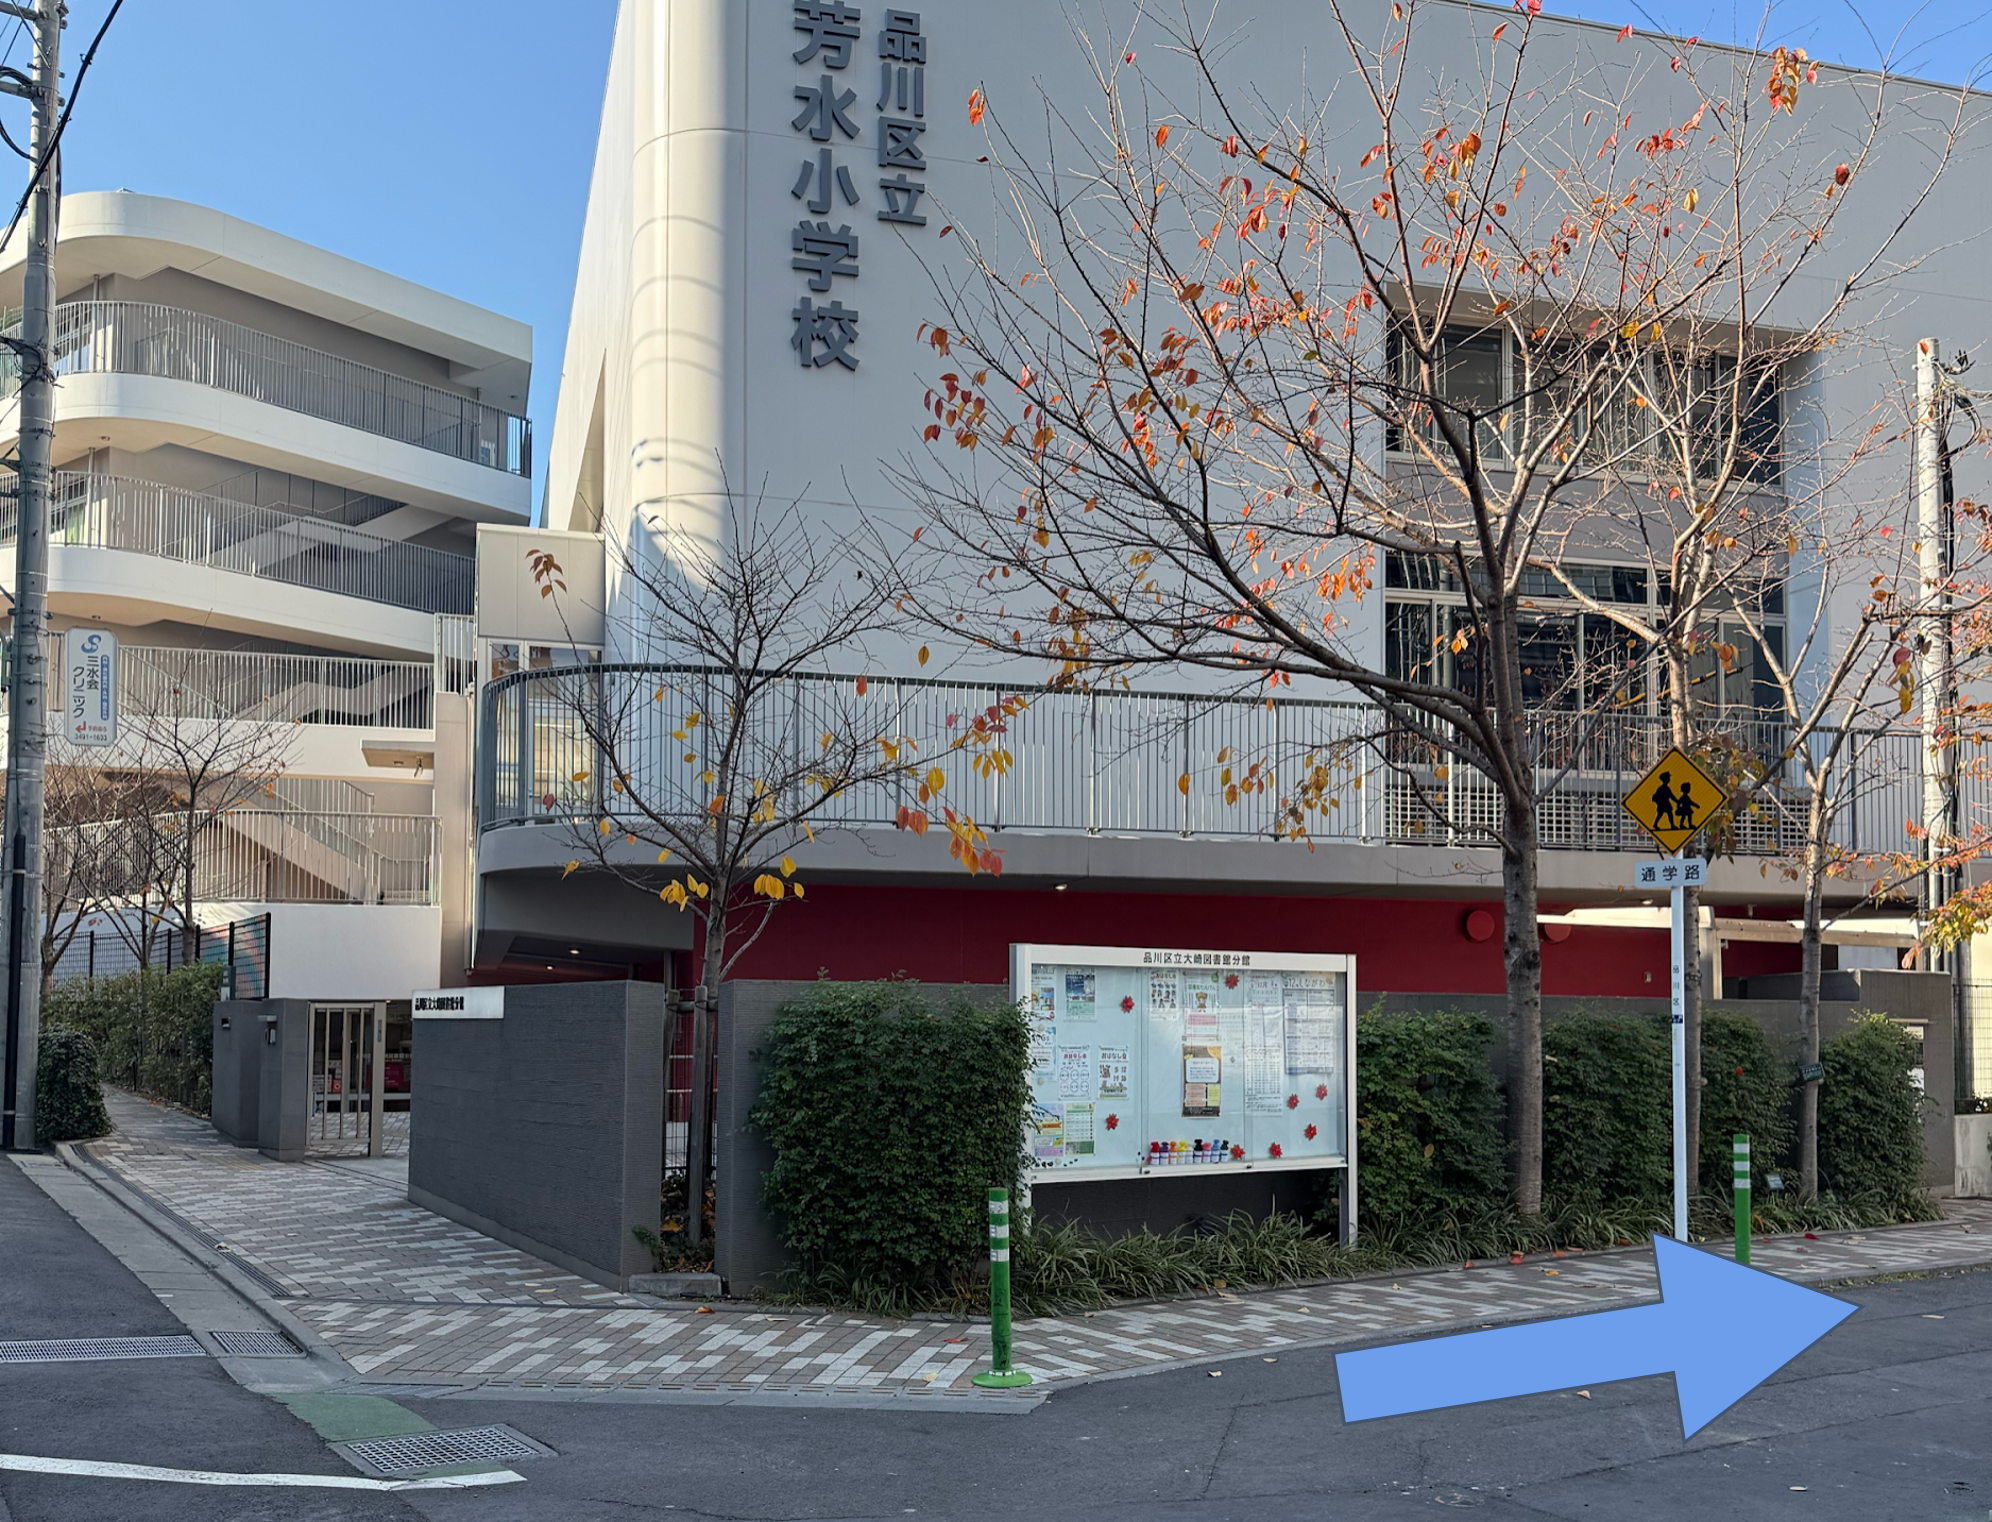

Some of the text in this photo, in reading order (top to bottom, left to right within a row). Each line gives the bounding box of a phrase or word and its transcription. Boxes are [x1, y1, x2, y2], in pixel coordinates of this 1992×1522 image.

[876, 8, 927, 227] 品川区立
[791, 0, 860, 372] 芳水小学校
[72, 666, 85, 719] クリニック
[86, 655, 99, 691] 三水会
[1641, 864, 1700, 883] 通学路
[1143, 952, 1251, 967] 品川区立大崎図書館分館
[1672, 965, 1680, 1006] 品川区
